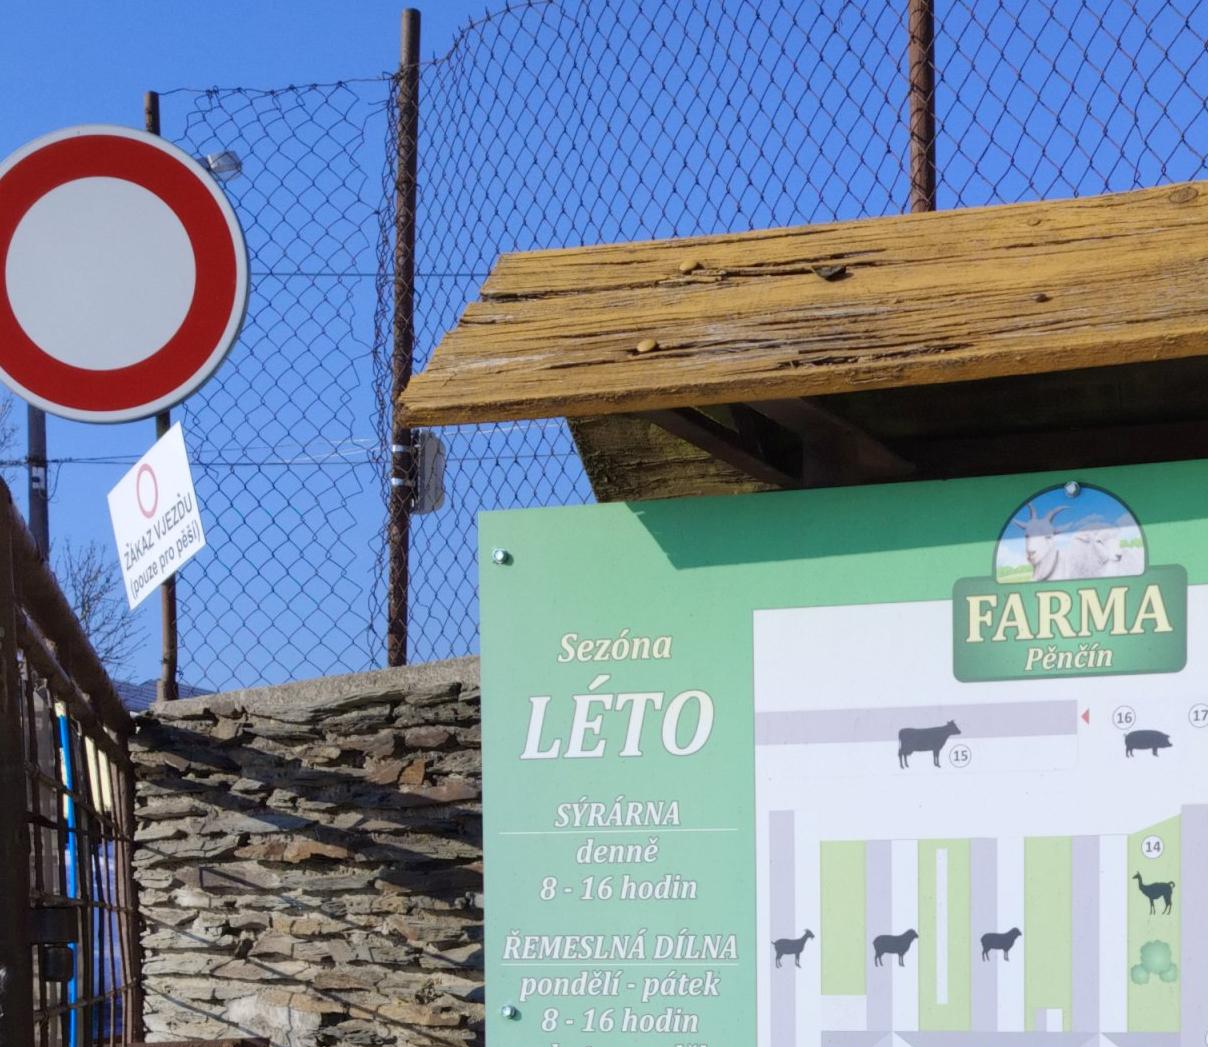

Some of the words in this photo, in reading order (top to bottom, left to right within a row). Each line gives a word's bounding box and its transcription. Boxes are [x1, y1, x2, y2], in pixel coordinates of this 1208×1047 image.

[130, 561, 158, 600] (pouze
[159, 546, 175, 574] pro
[176, 519, 200, 558] pěší)
[965, 584, 1173, 643] FARMA
[557, 628, 673, 662] Sezóna
[1024, 642, 1113, 672] Pěnčín
[520, 674, 716, 760] LÉTO
[1117, 711, 1132, 724] 16
[1193, 709, 1208, 722] 17
[953, 750, 968, 762] 15
[554, 796, 680, 828] SÝRÁRNA
[575, 836, 659, 864] denně
[1145, 841, 1161, 853] 14
[540, 876, 557, 901] 8
[580, 876, 613, 900] 16
[620, 874, 698, 901] hodin
[502, 929, 645, 960] ŘEMESLNÁ
[652, 928, 739, 961] DÍLNA
[519, 969, 621, 1000] pondělí
[641, 970, 721, 1002] pátek
[541, 1008, 559, 1033] 8
[581, 1008, 615, 1033] 16
[621, 1007, 699, 1034] hodin
